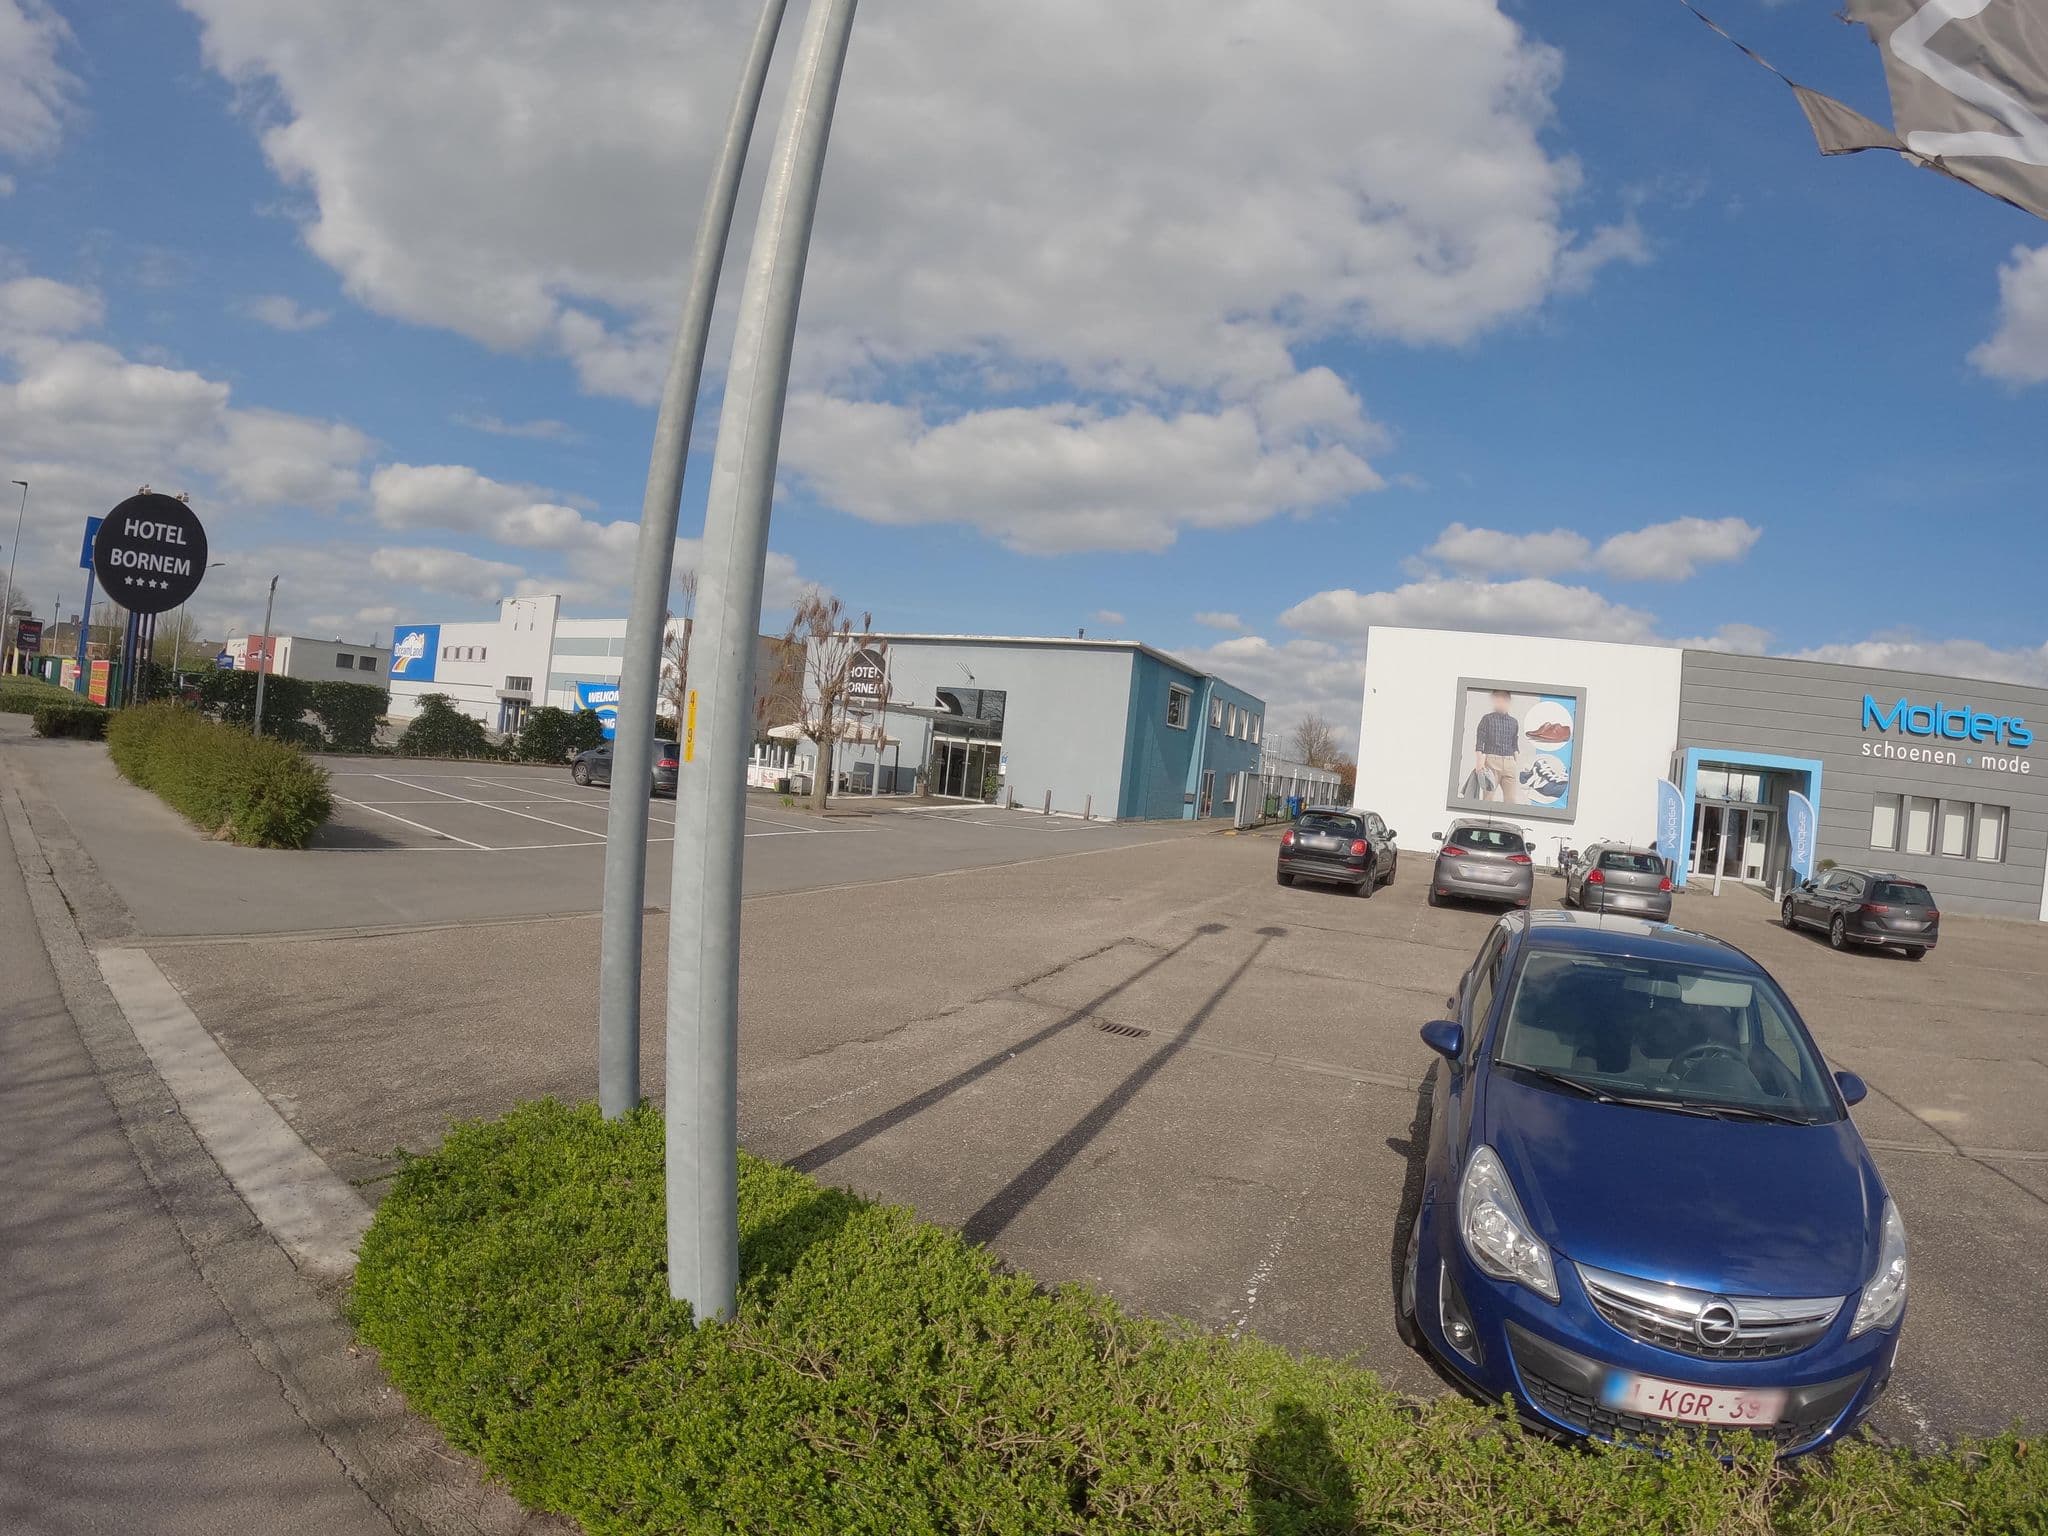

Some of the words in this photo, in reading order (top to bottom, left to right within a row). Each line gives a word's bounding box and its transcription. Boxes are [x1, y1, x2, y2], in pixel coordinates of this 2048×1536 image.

[124, 518, 187, 545] HOTEL
[110, 548, 191, 577] BORNEM
[847, 681, 882, 694] ORNEM
[1862, 693, 2033, 746] Molders
[1861, 740, 1956, 765] schoenen
[1981, 755, 2031, 774] mode
